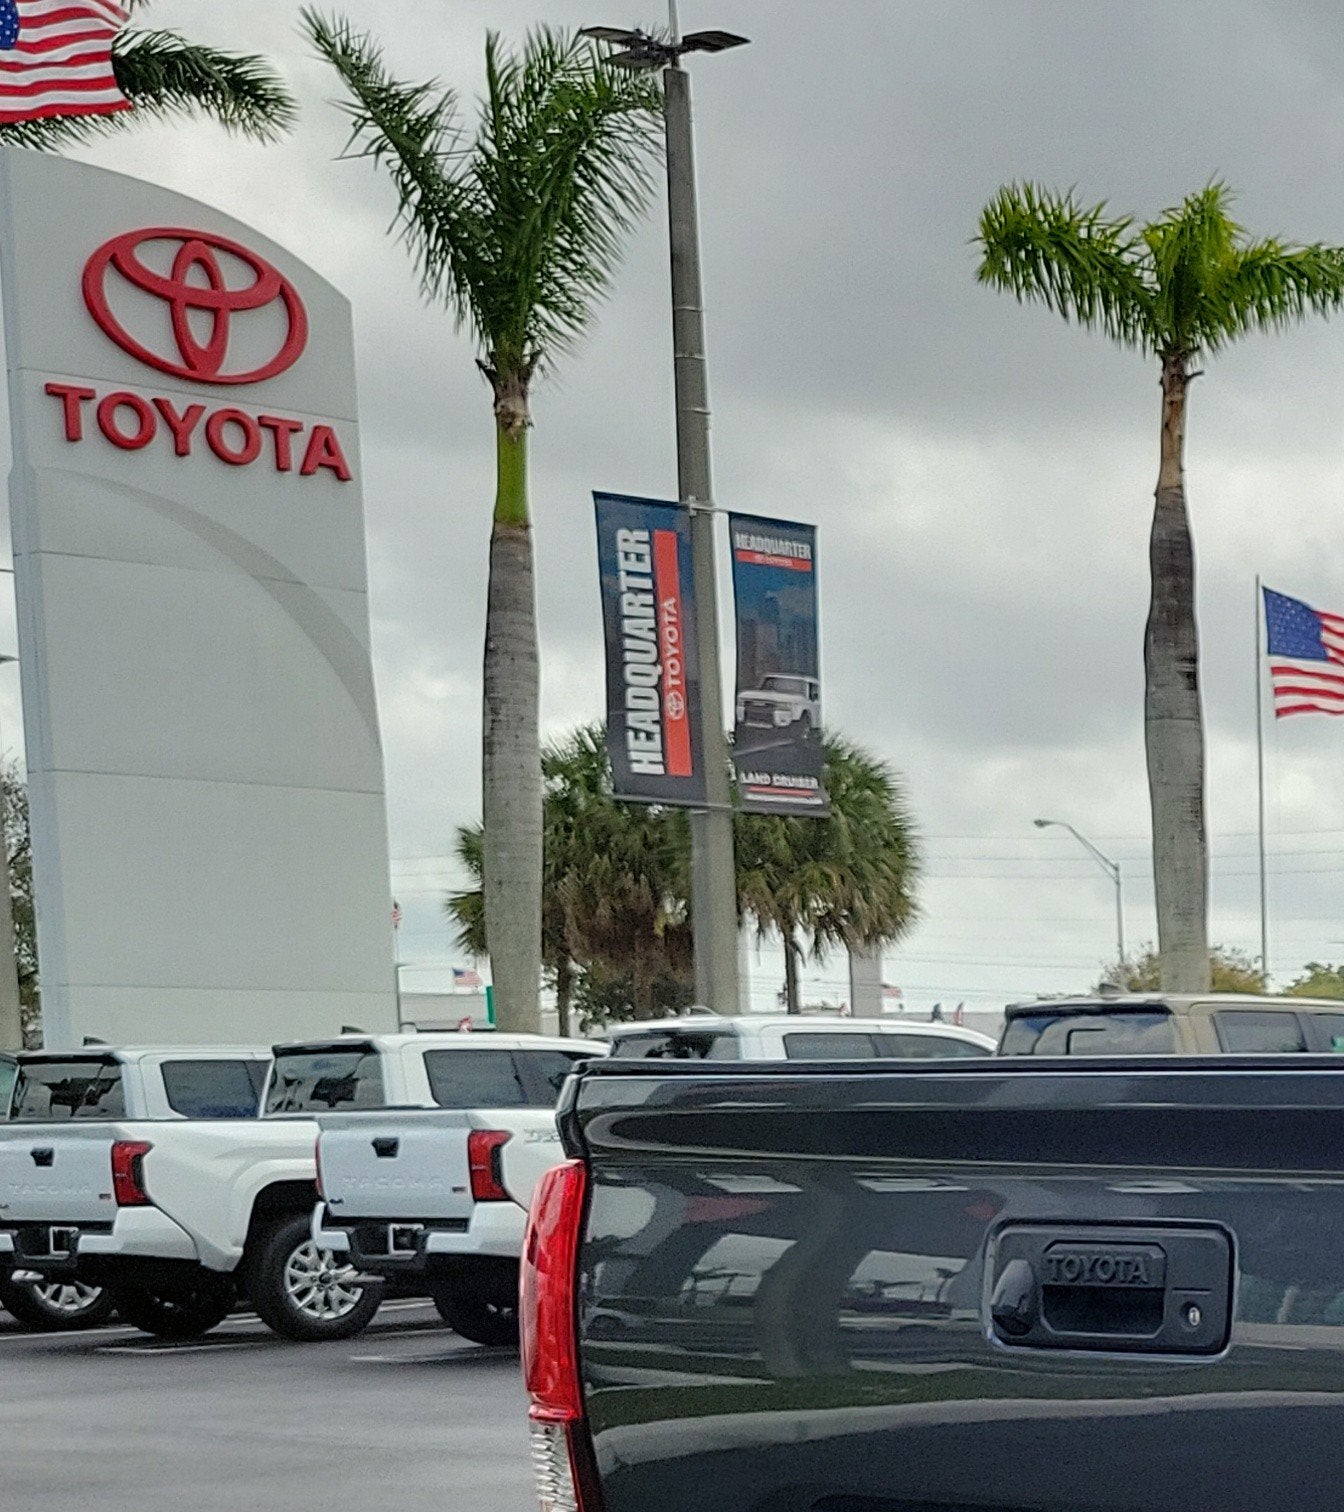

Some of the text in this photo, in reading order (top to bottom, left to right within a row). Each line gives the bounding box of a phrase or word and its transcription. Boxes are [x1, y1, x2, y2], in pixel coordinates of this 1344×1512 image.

[45, 383, 352, 482] TOYOTA
[616, 527, 666, 776] HEADQUARTER
[661, 597, 684, 688] TOYOTA
[1047, 1253, 1149, 1284] TOYOTA
